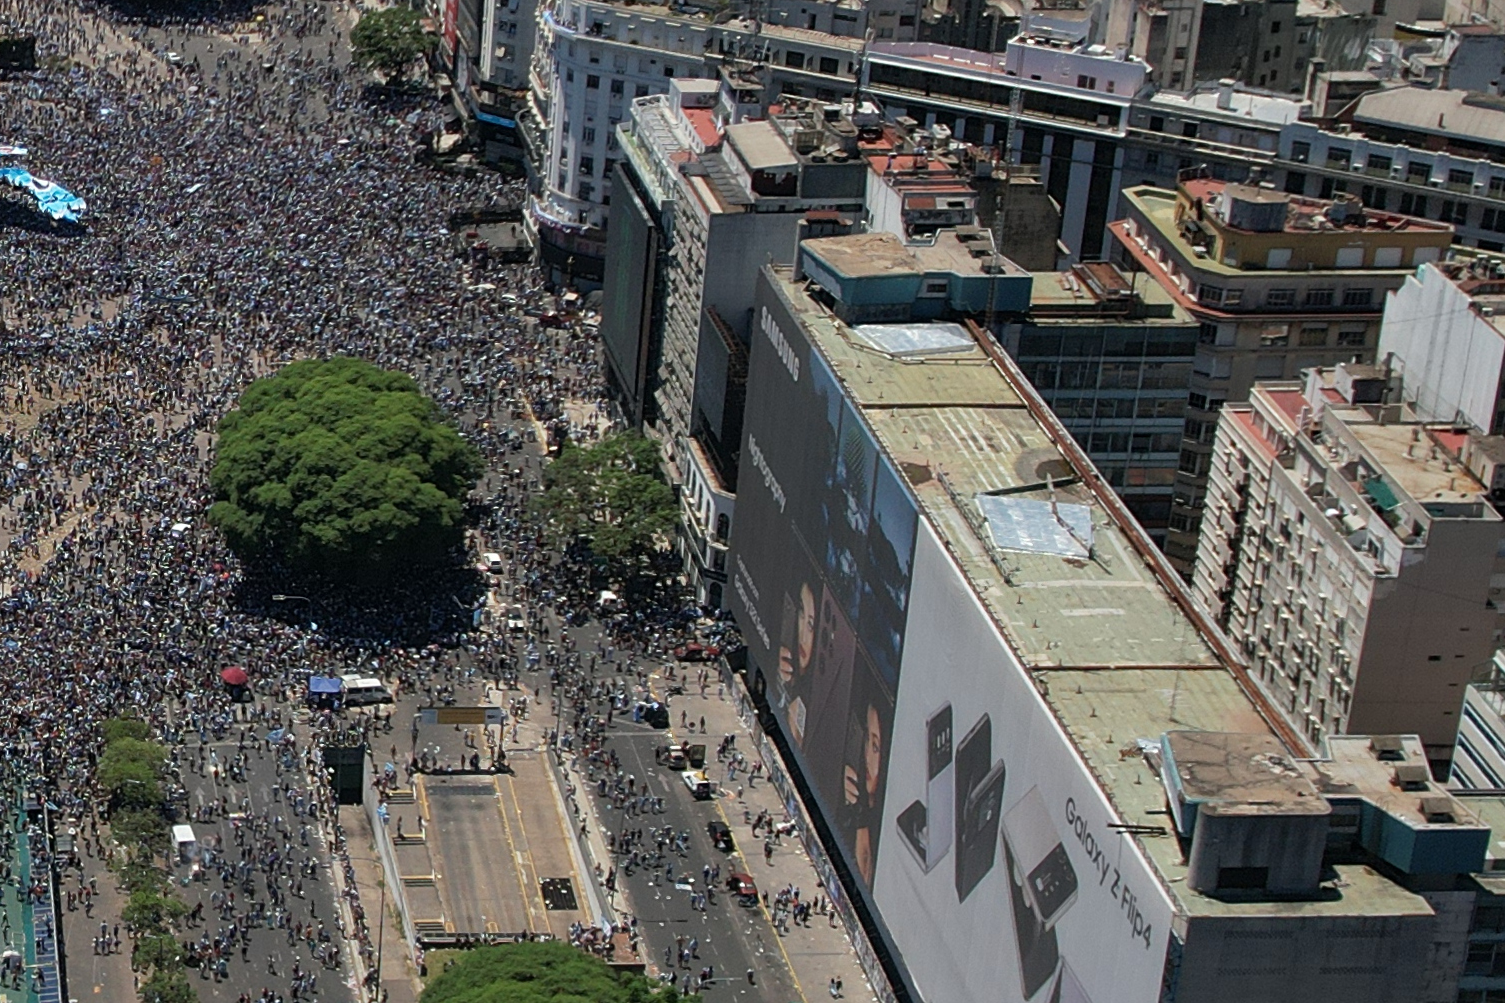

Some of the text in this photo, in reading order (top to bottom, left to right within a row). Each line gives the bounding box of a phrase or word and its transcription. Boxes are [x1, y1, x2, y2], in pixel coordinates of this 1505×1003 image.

[761, 306, 799, 382] SAMSUNG
[1065, 797, 1152, 950] Galaxy Z Flip4
